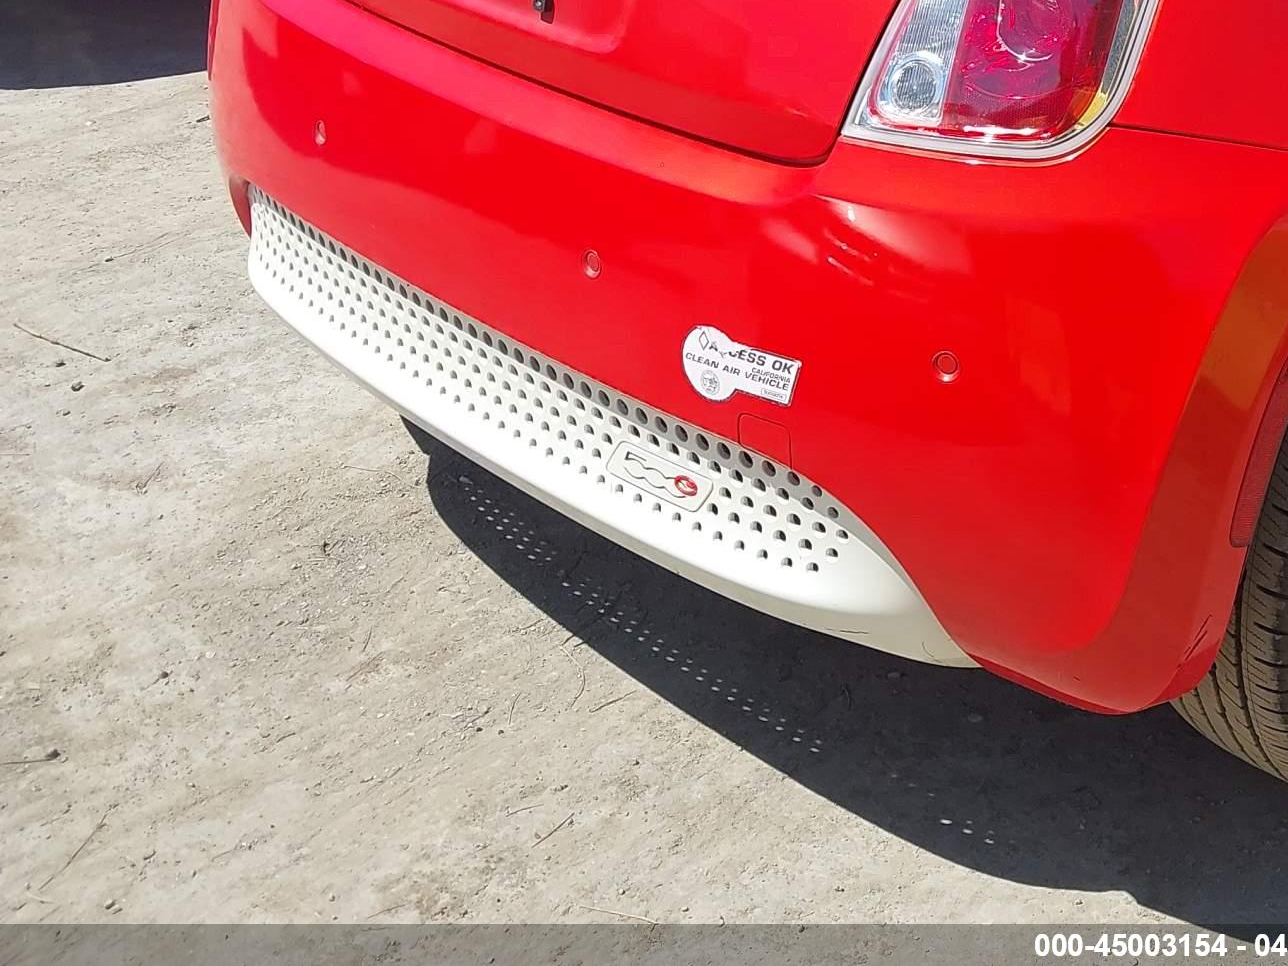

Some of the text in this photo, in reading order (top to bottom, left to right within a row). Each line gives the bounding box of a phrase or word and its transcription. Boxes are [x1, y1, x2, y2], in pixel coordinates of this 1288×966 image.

[685, 352, 789, 391] CLEAN AIR VEHICLE
[752, 367, 791, 384] CALIFORNIA
[771, 359, 794, 375] OK
